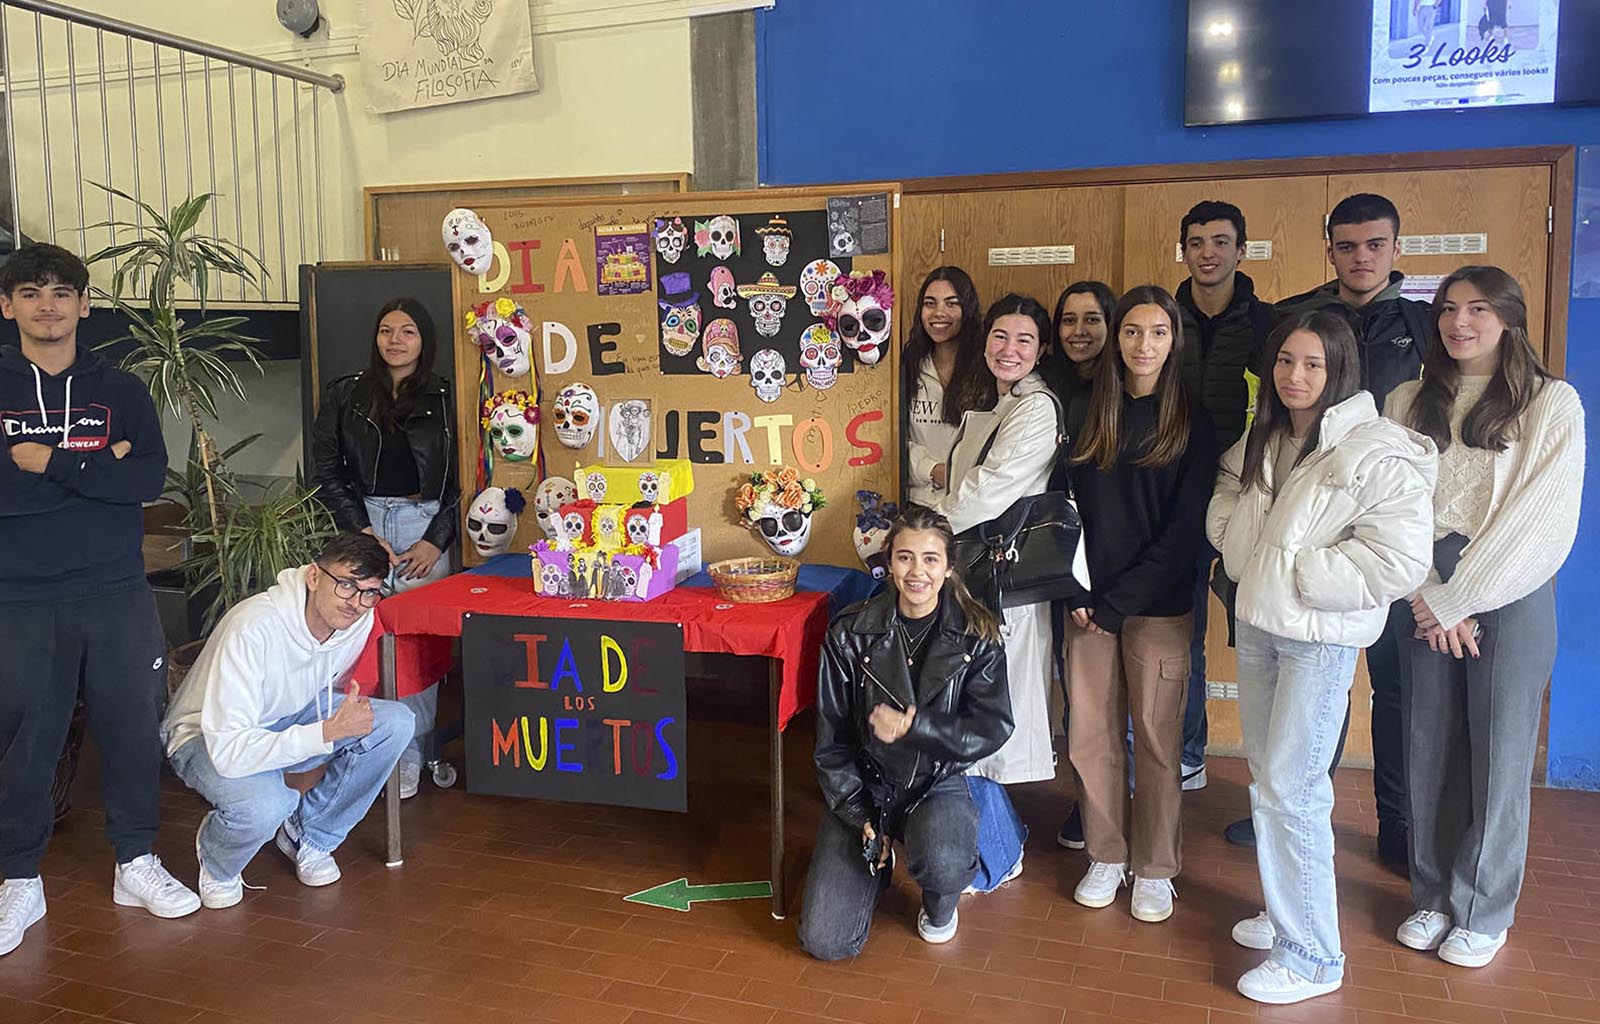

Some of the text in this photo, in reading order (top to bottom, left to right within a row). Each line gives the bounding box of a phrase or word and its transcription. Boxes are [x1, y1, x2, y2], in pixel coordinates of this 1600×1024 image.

[1402, 39, 1516, 69] 3 Looks
[1373, 66, 1549, 85] Com poucas peças, consegues vários looks!
[478, 239, 588, 294] DIA
[543, 321, 625, 376] DE
[601, 634, 660, 695] DE
[564, 695, 596, 711] LOS
